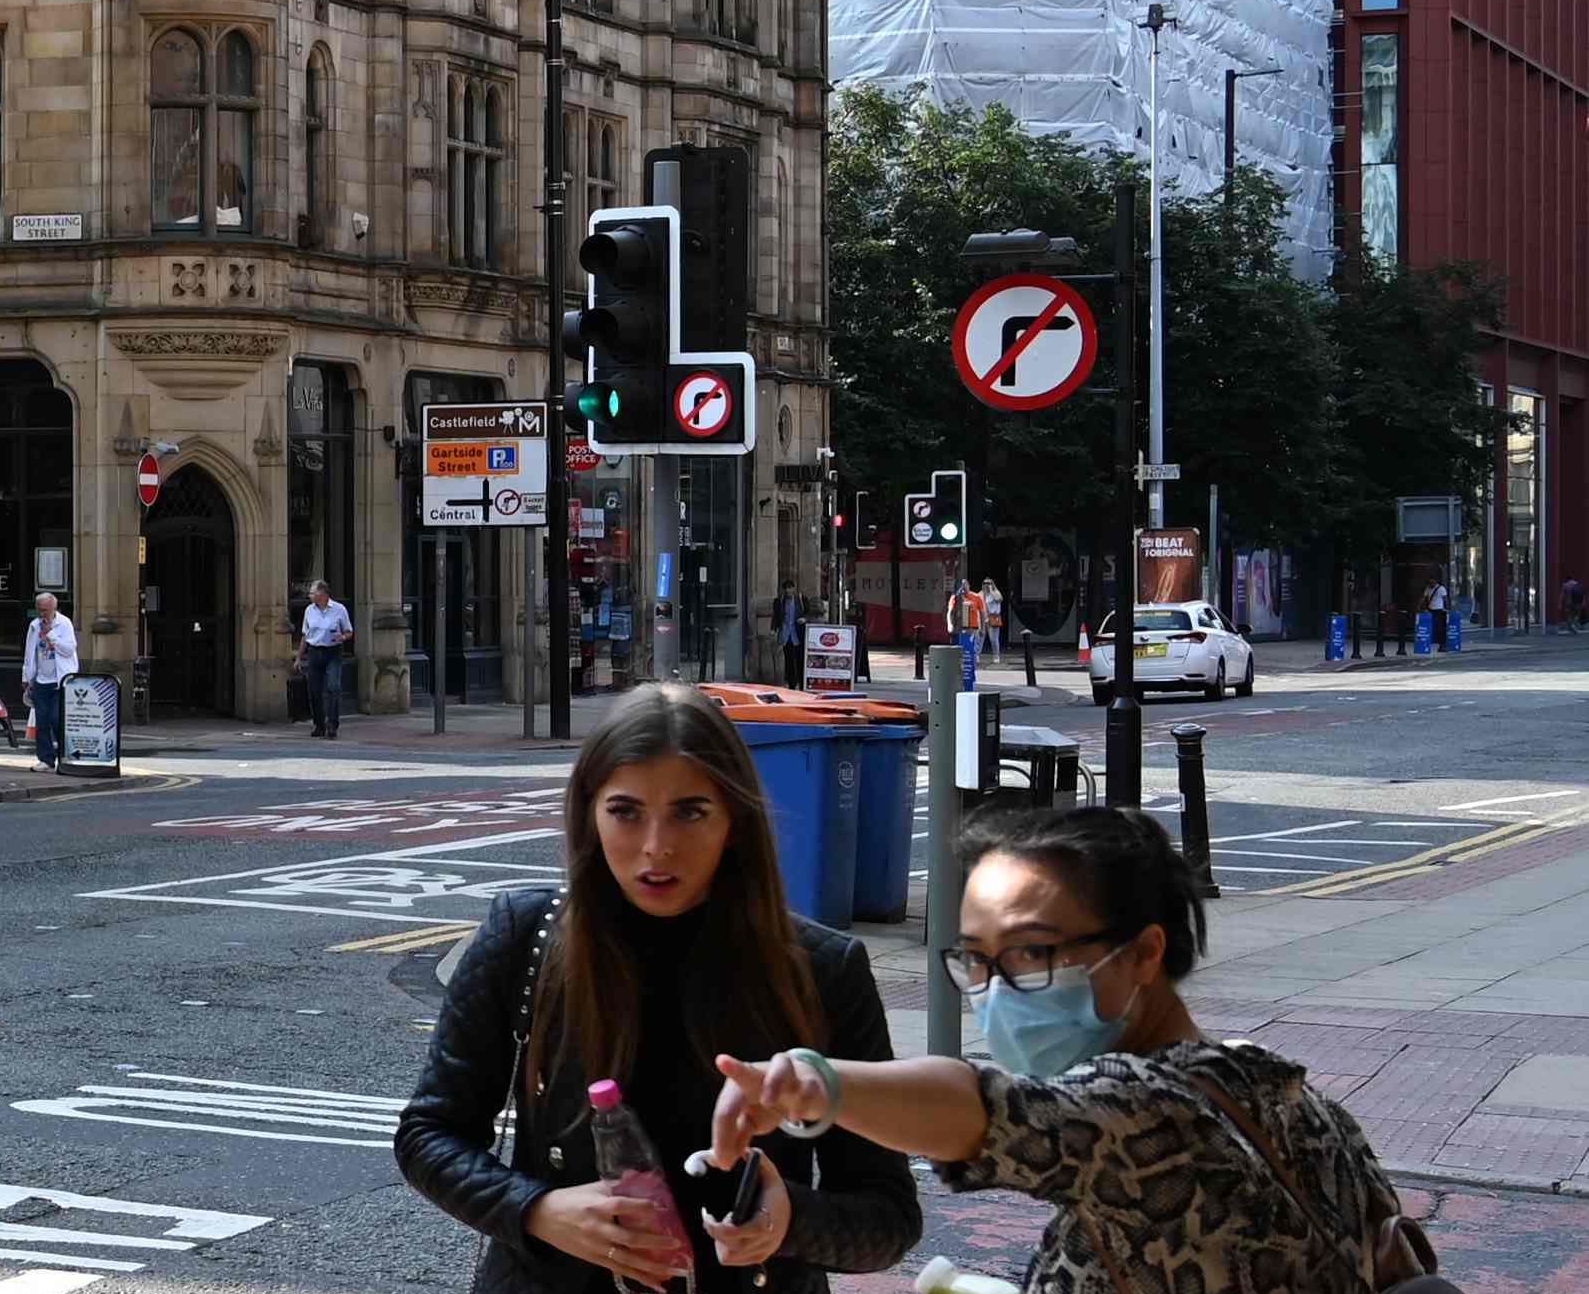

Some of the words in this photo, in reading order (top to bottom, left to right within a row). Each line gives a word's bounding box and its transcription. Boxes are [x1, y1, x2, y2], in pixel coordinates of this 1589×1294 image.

[15, 218, 50, 227] SOUTH
[54, 217, 80, 226] KING
[28, 228, 66, 237] STREET
[430, 416, 496, 428] Castlefield
[431, 448, 482, 458] Gartside
[569, 445, 592, 454] POST
[566, 454, 596, 464] OFFICE
[438, 461, 476, 473] Street
[430, 509, 475, 520] Central
[862, 578, 939, 589] MOLEY
